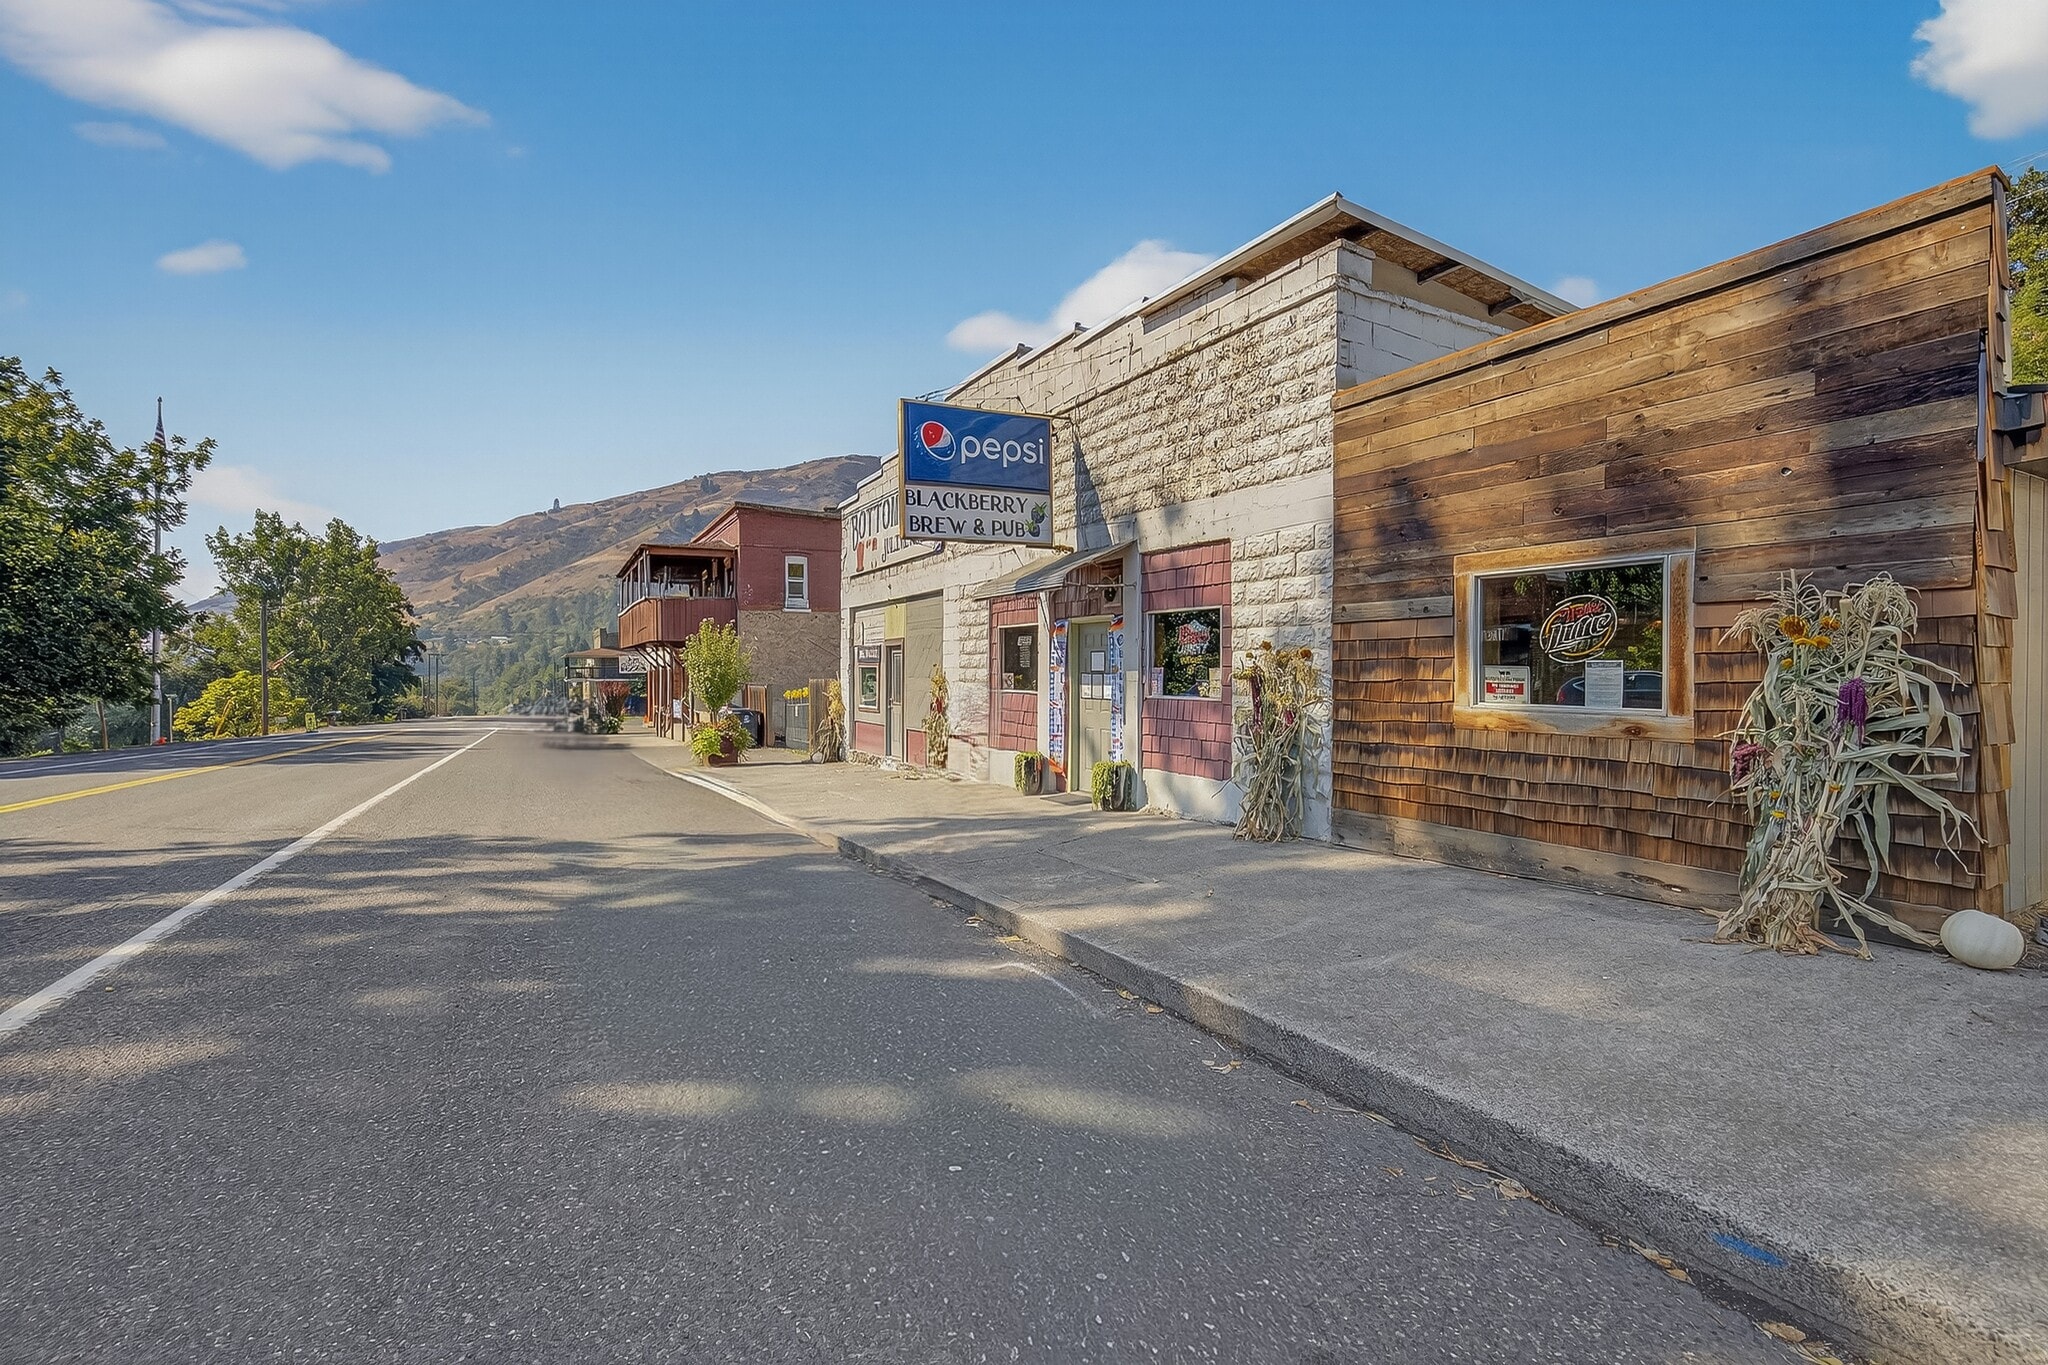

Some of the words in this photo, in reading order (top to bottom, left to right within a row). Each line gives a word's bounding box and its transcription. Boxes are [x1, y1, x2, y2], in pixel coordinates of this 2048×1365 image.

[961, 435, 1044, 468] pepsi
[906, 489, 1028, 515] BLACKBERRY
[909, 514, 967, 535] BREW
[973, 518, 987, 536] &
[991, 519, 1026, 538] PUB
